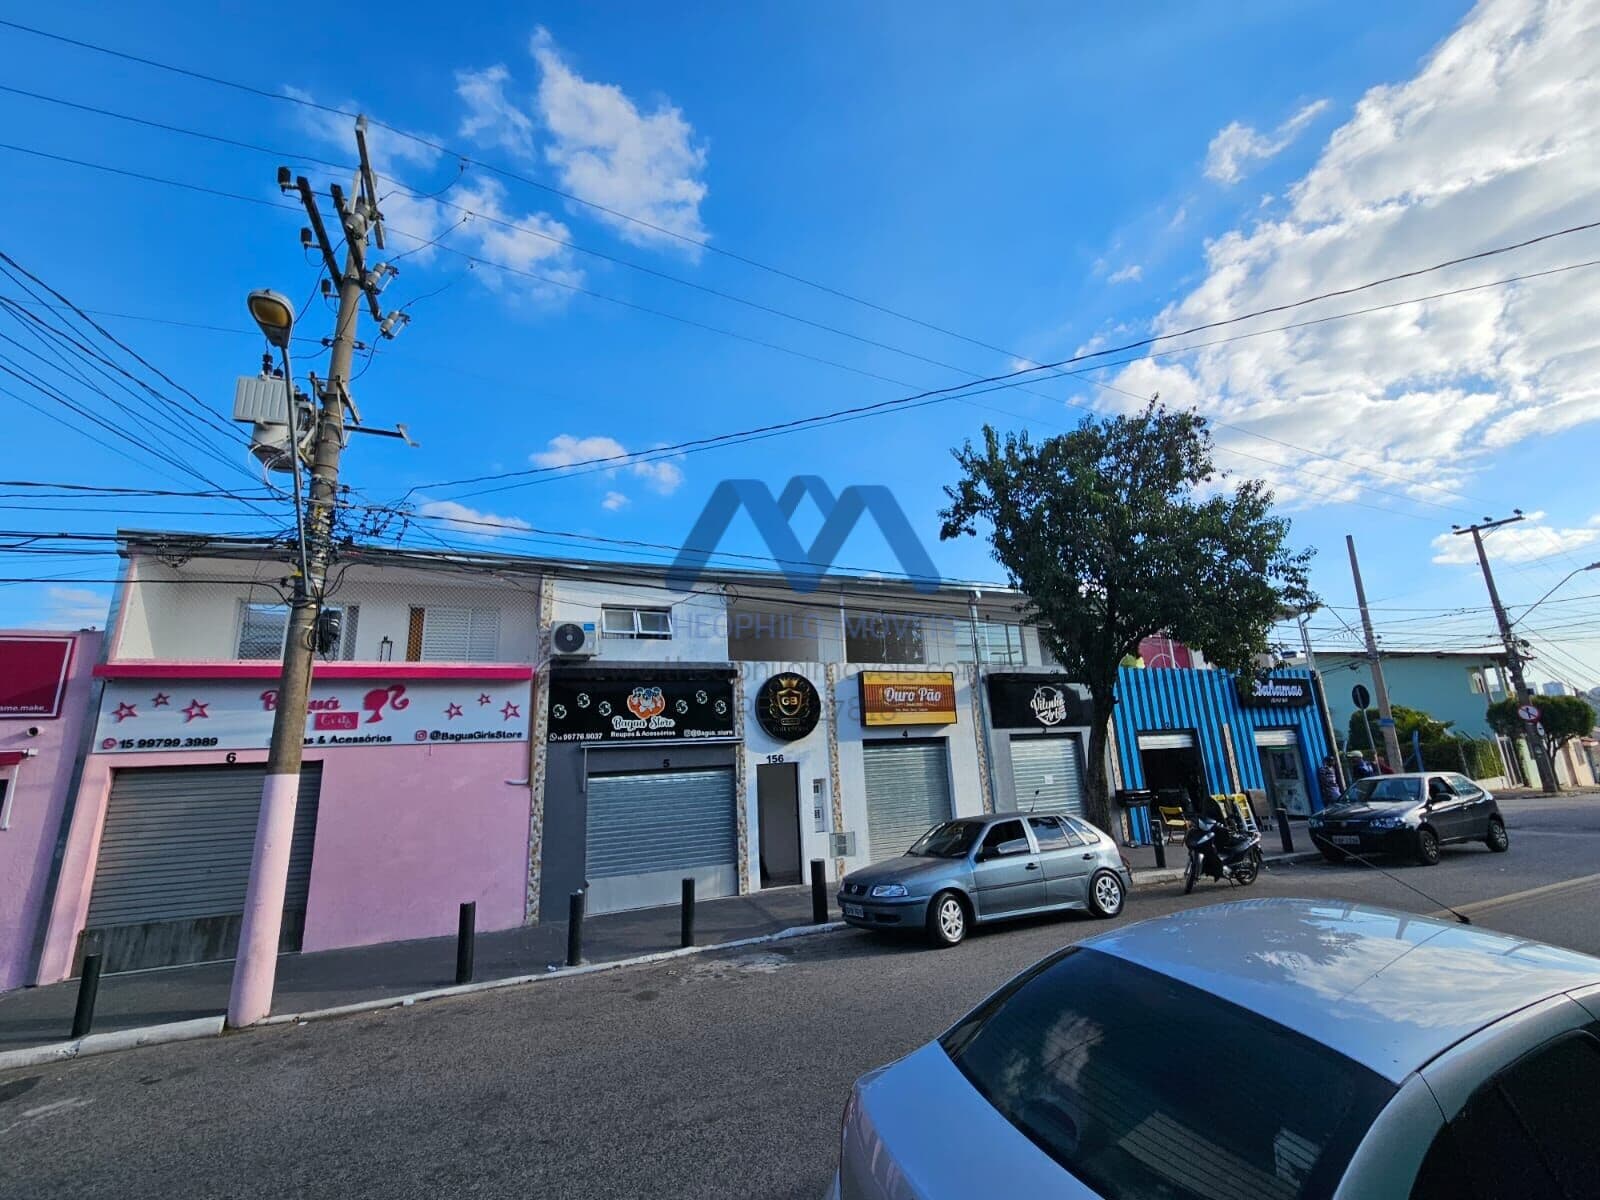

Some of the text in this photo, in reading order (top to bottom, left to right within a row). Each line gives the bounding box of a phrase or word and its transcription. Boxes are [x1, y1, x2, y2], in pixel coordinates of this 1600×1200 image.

[1251, 679, 1303, 697] Bahamas
[884, 687, 941, 702] Ouro Pão
[781, 696, 798, 706] GB
[328, 734, 392, 744] Acessórios
[902, 730, 908, 738] 4
[119, 737, 218, 749] 15 99799.3989
[226, 752, 236, 764] 6
[766, 754, 784, 763] 156
[663, 759, 670, 768] 5
